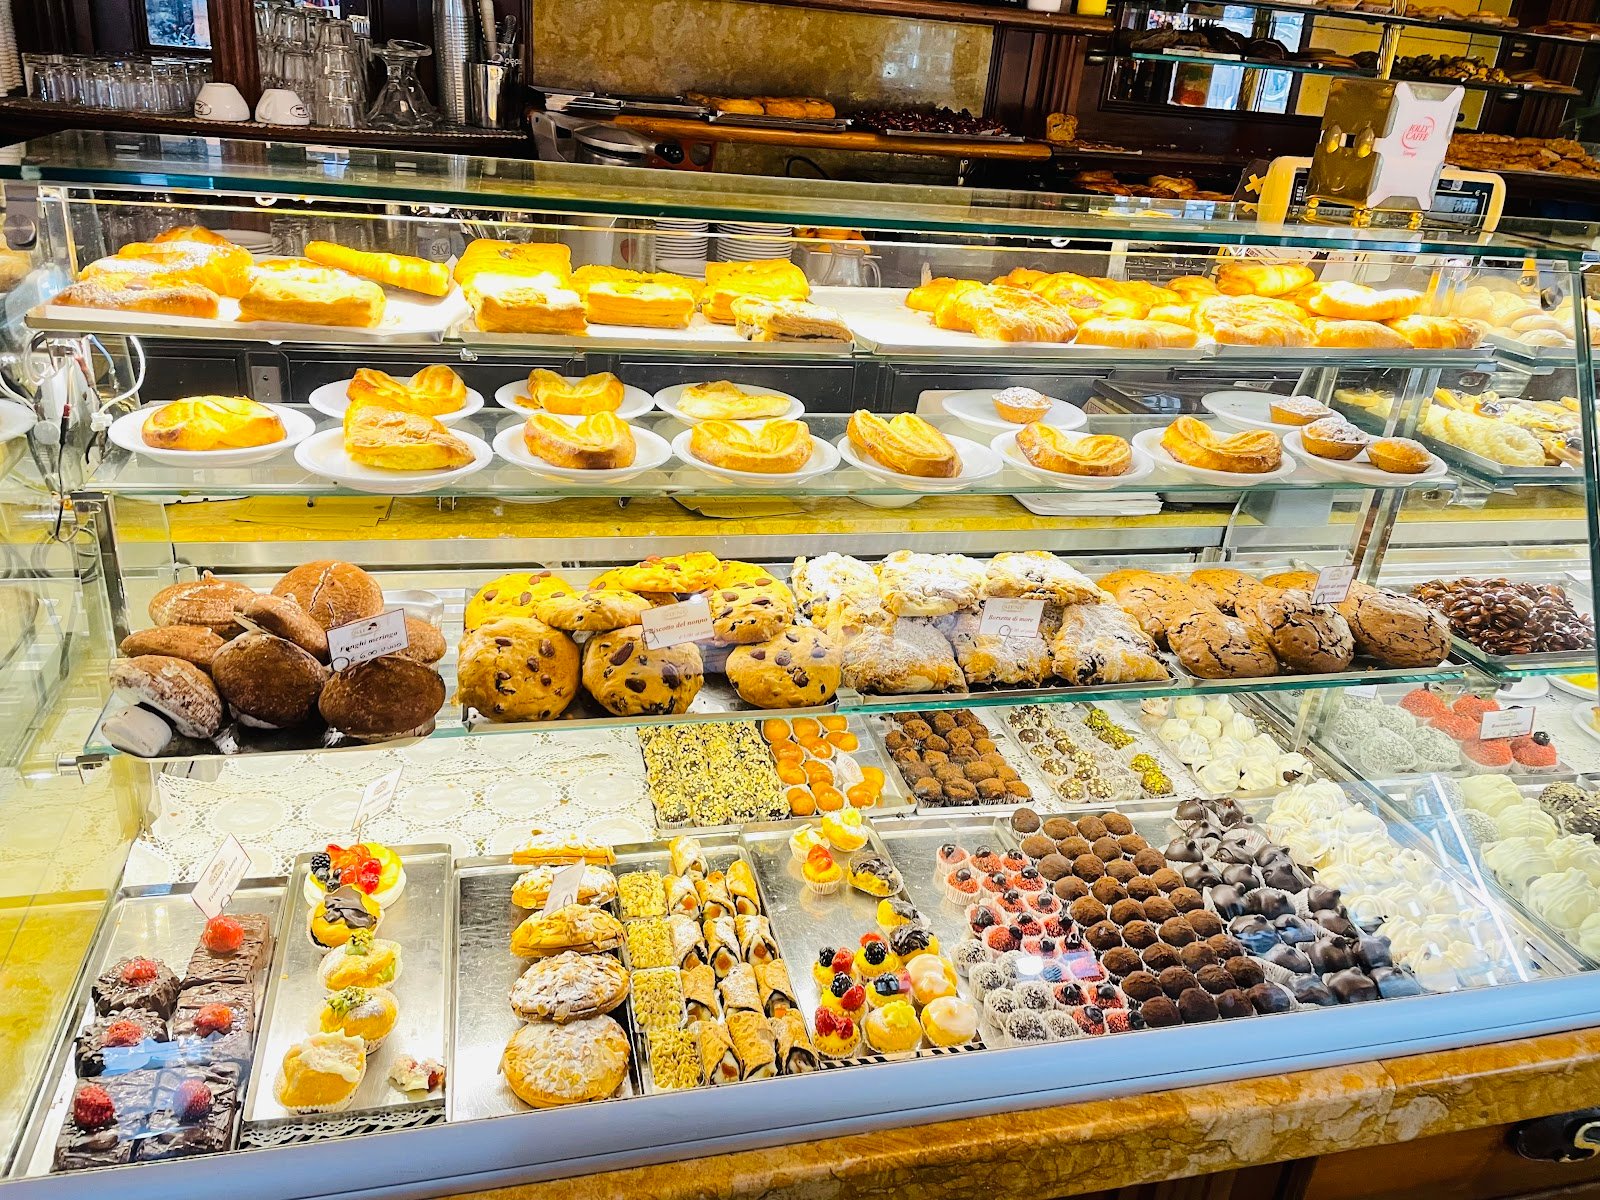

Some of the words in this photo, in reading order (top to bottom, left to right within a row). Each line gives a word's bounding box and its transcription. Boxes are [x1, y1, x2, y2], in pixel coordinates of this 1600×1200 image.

[1408, 124, 1432, 133] JOLLY
[676, 620, 686, 629] del
[688, 617, 708, 625] nonno
[369, 631, 398, 645] meringa
